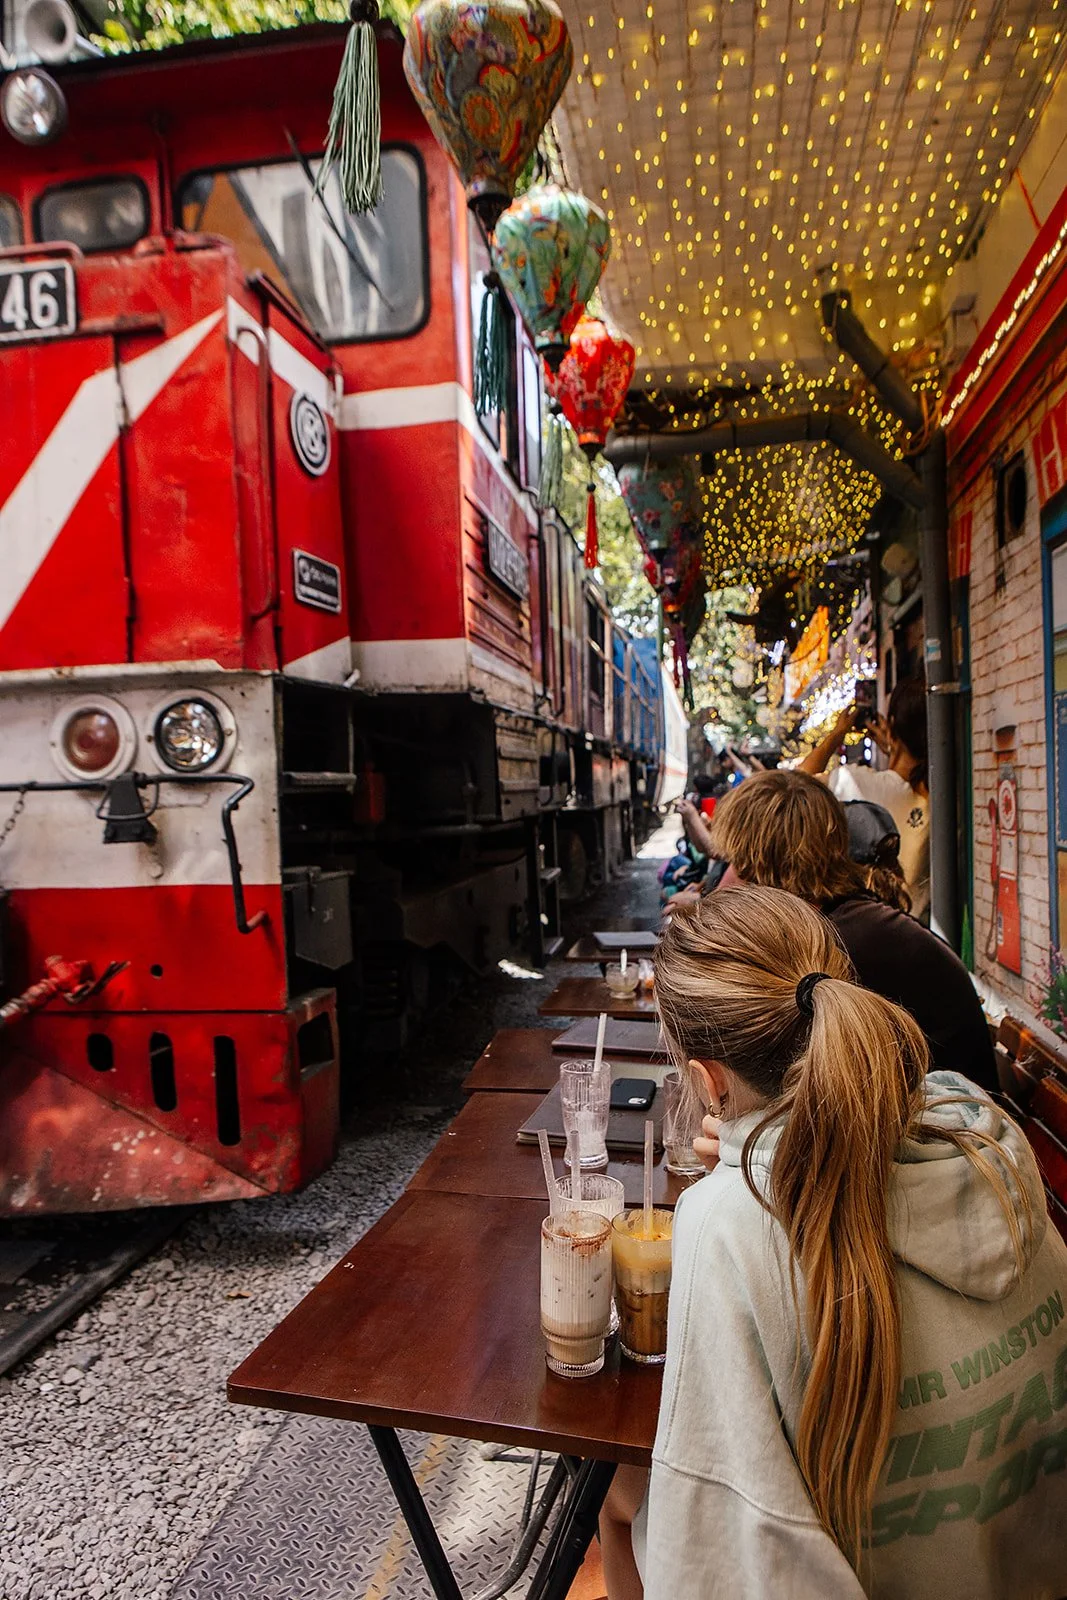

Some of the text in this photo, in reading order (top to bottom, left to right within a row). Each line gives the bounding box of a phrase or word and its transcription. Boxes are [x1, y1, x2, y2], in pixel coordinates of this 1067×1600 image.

[1, 270, 60, 330] 46
[898, 1289, 1065, 1411] MR WINSTON
